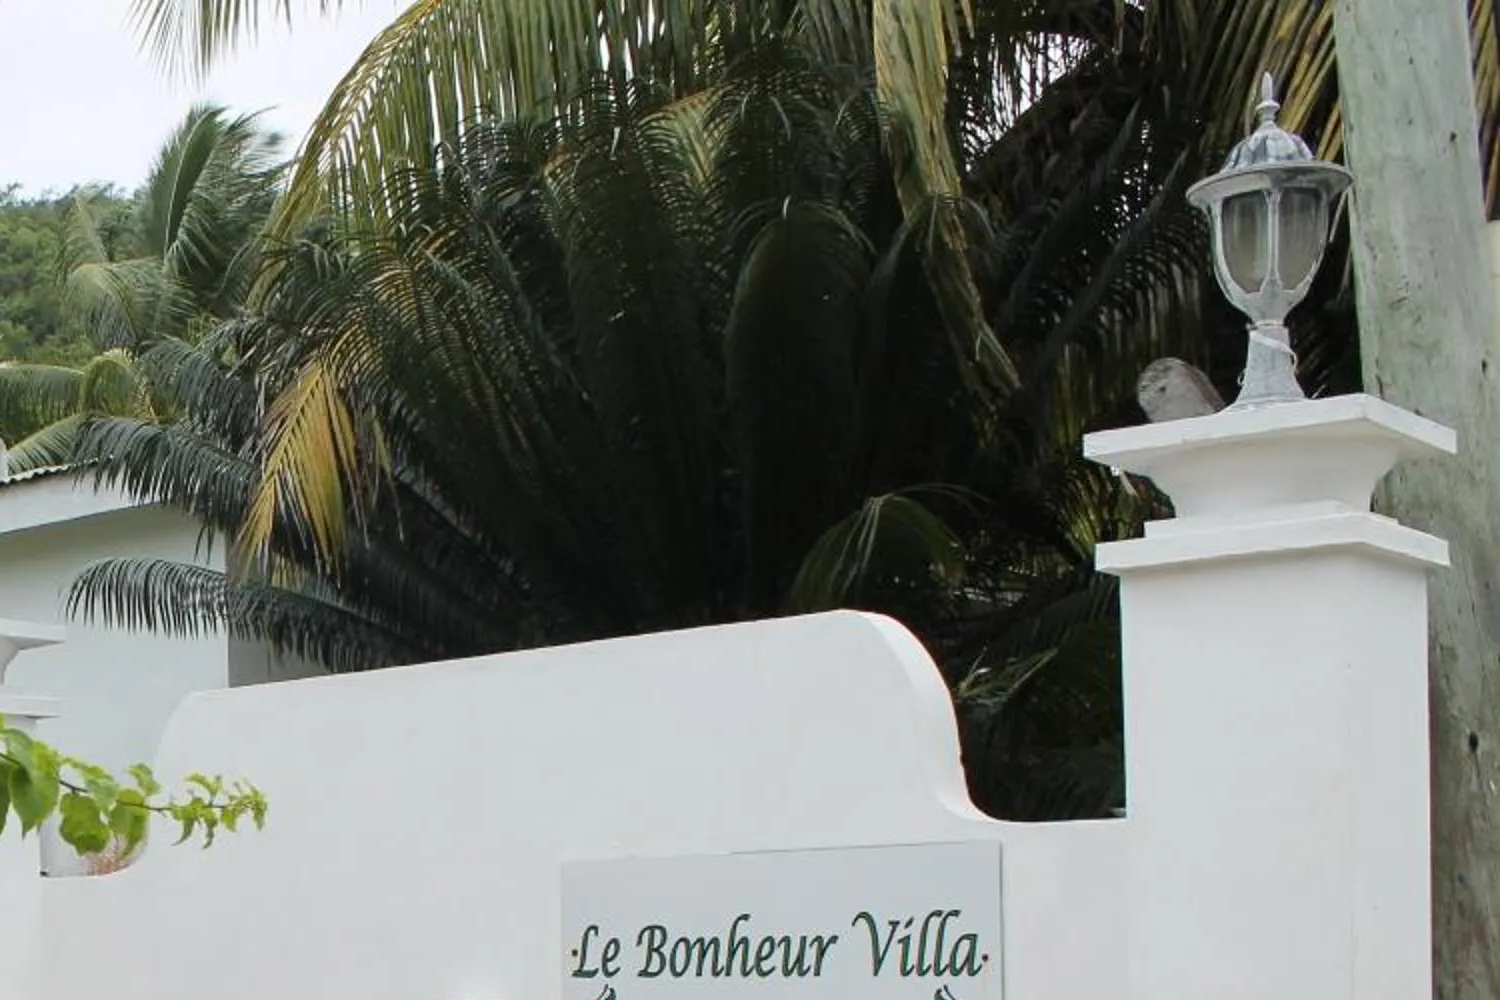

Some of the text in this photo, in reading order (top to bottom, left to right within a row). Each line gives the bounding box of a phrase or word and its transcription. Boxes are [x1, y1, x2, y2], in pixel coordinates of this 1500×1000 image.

[571, 910, 982, 978] Le Bonheur Villa
